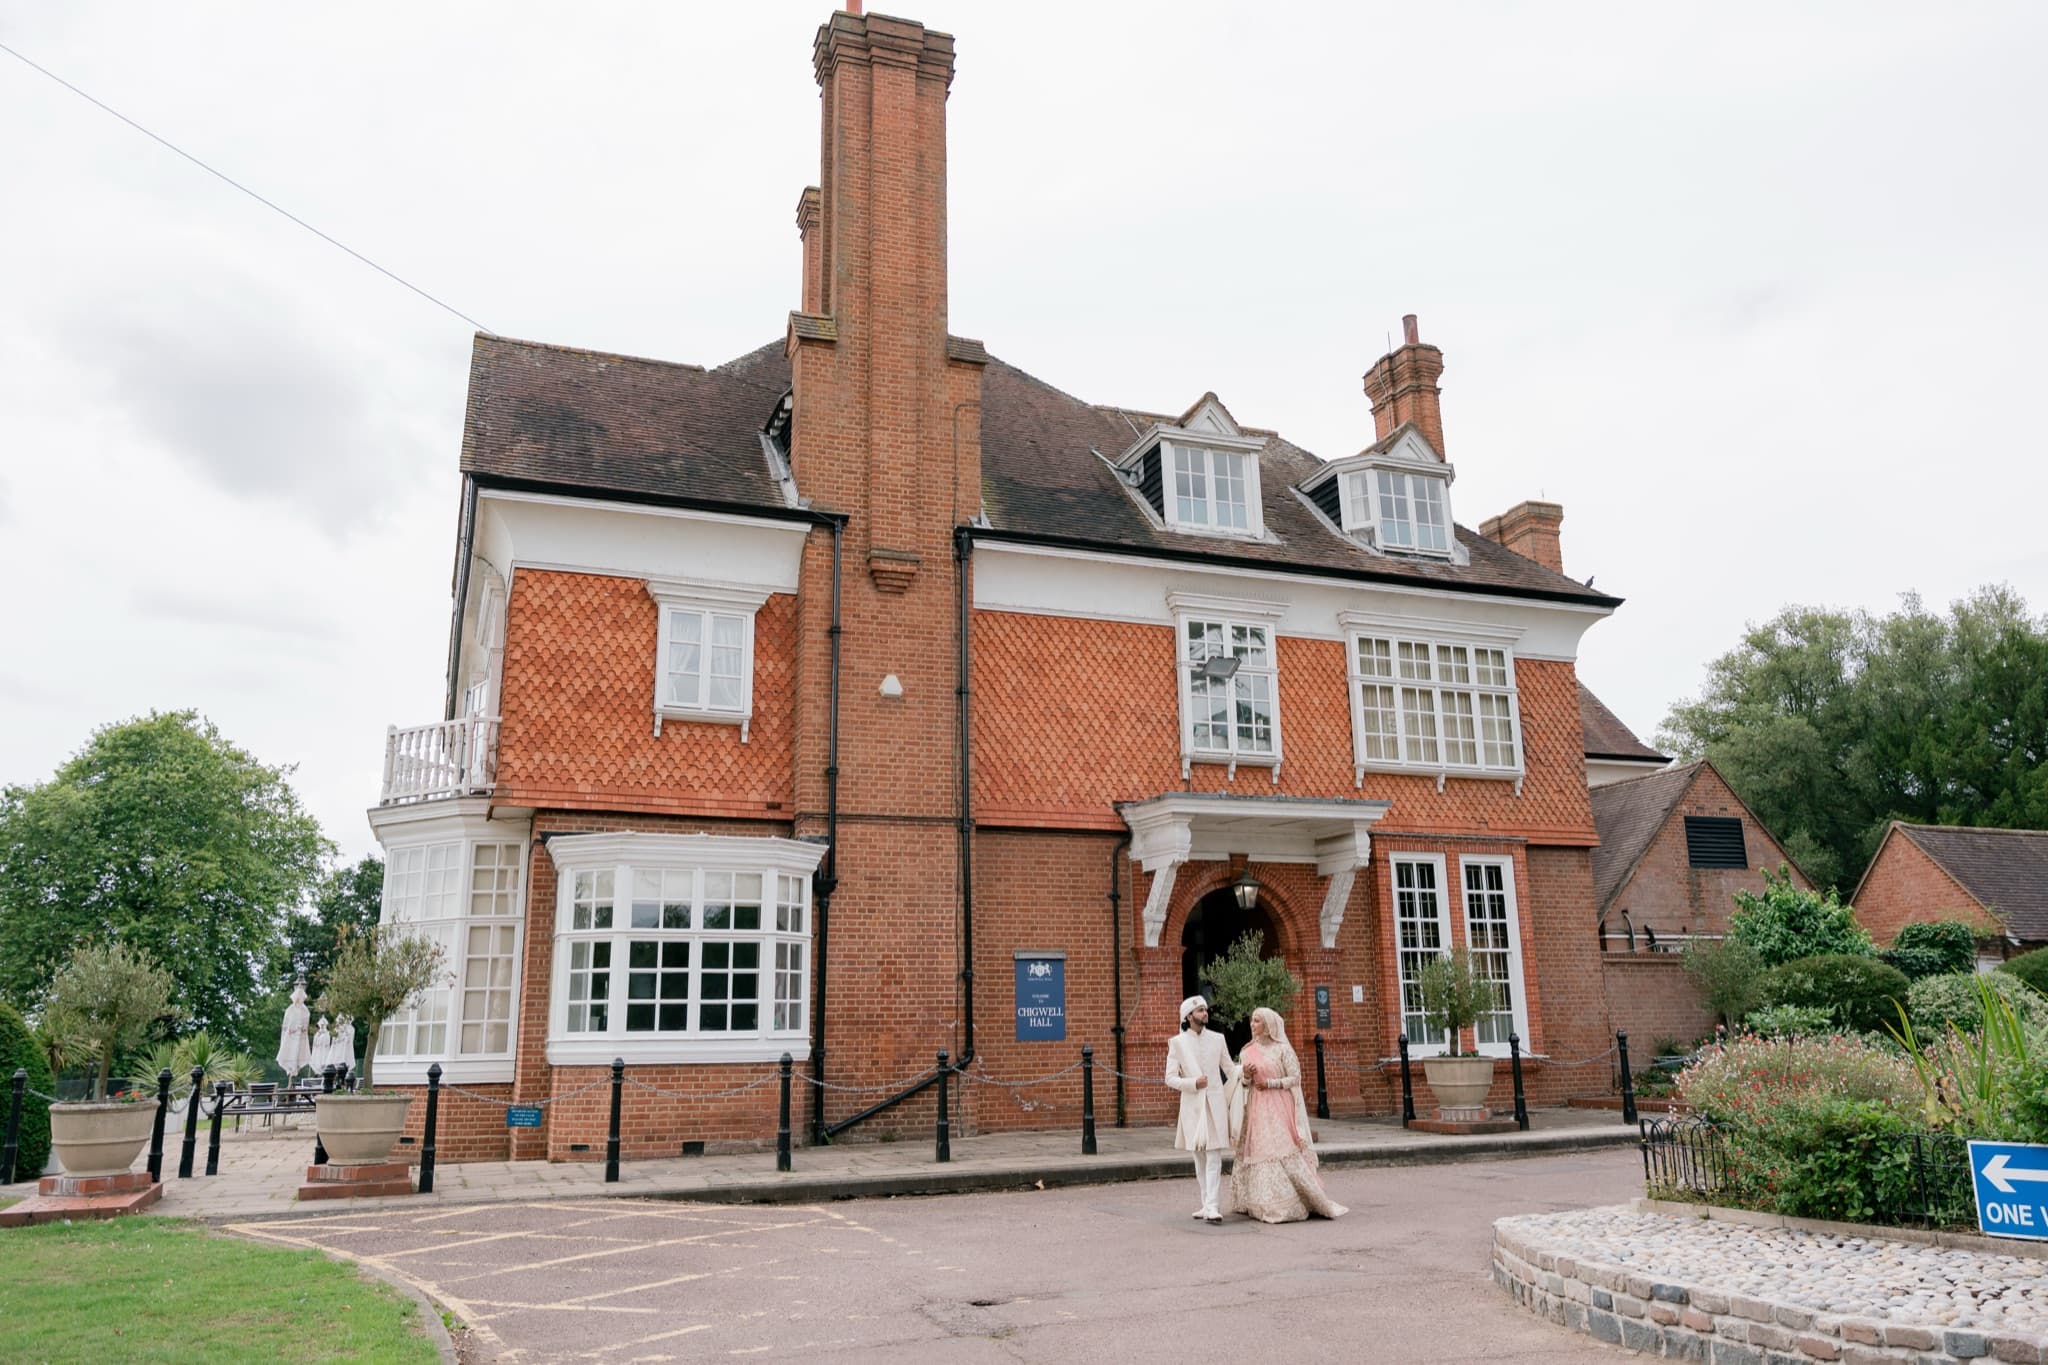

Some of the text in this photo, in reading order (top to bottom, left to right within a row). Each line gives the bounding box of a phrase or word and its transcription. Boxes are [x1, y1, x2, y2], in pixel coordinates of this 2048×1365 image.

[1018, 1007, 1063, 1016] CHIGWELL
[1030, 1017, 1052, 1027] HALL
[1986, 1202, 2034, 1226] ONE
